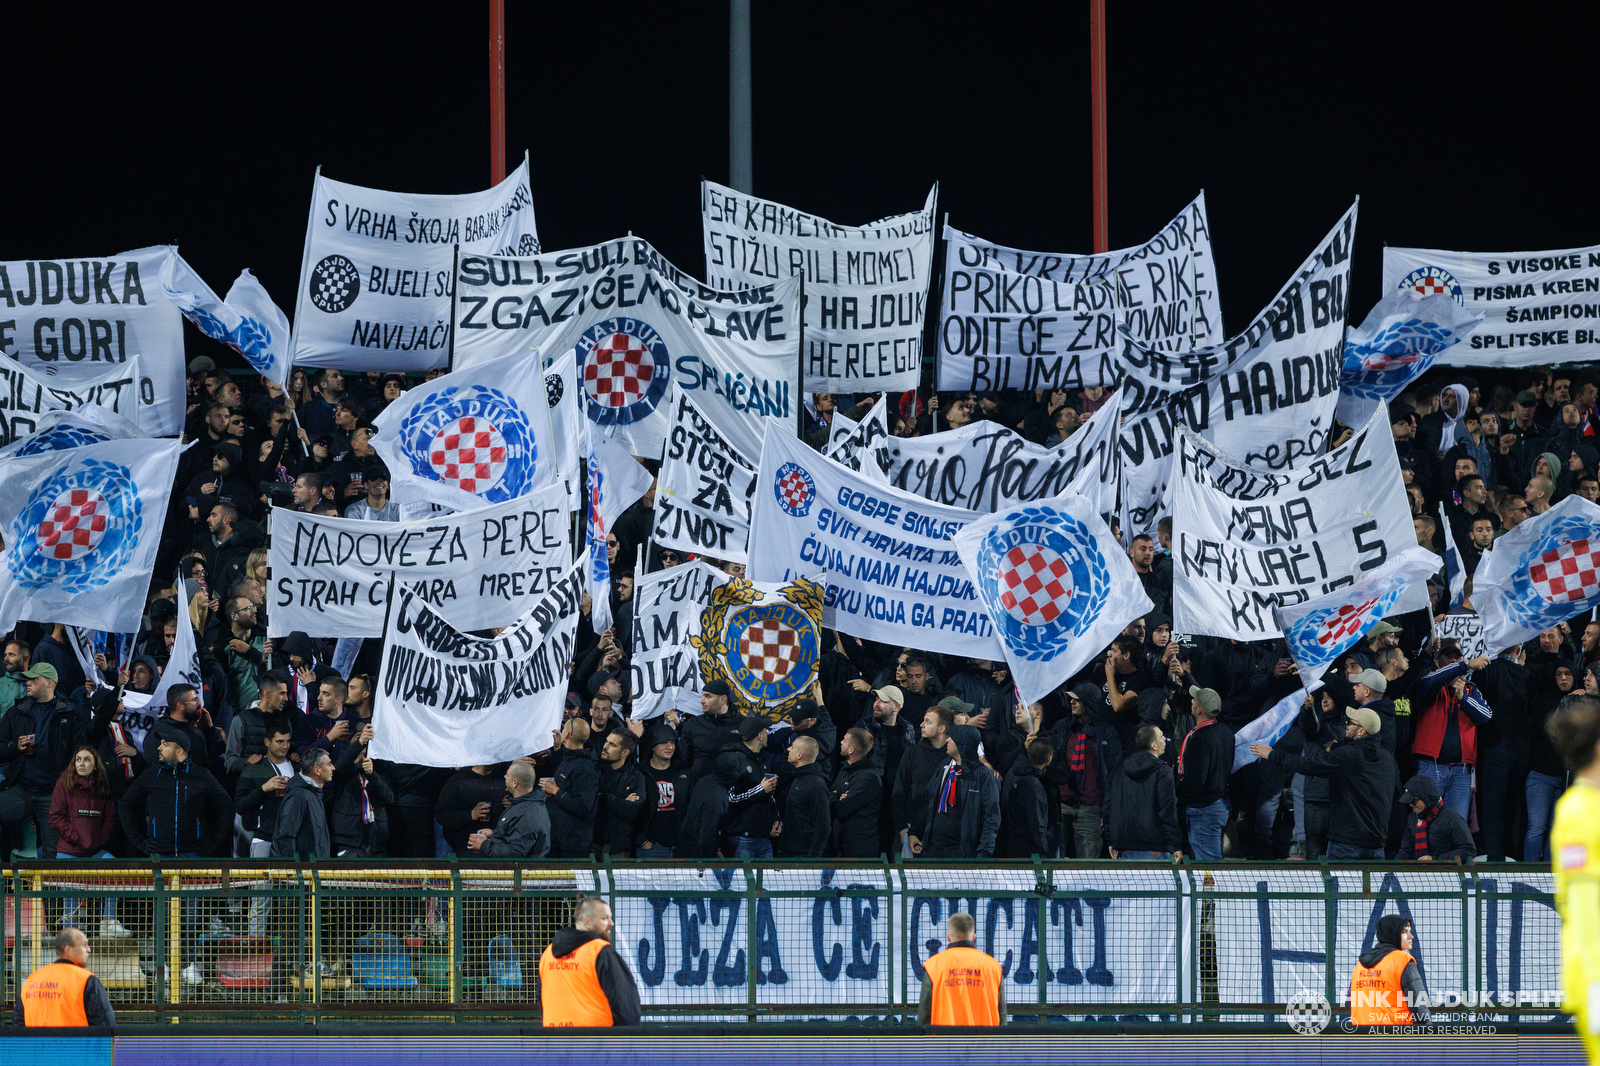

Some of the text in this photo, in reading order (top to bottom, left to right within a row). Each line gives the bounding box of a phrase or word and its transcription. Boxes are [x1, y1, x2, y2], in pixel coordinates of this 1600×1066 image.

[325, 199, 339, 227] S
[345, 204, 397, 241] VRHA
[405, 211, 460, 244] ŠKOJA
[315, 256, 358, 282] HAJDUK
[710, 230, 779, 279] STIŽU
[847, 247, 916, 286] MOMCI
[1487, 262, 1501, 275] S
[1506, 254, 1582, 275] VISOKE
[368, 265, 429, 298] BIJELI
[951, 270, 1043, 314] PRIKO
[1401, 266, 1459, 290] HAJDUK
[1473, 282, 1536, 301] PISMA
[313, 294, 346, 312] SPLIT
[1506, 303, 1600, 324] ŠAMPION
[33, 317, 127, 362] GORI
[350, 319, 449, 351] NAVIJAČI
[577, 319, 664, 352] HAJDUK
[943, 313, 1010, 357] ODIT
[1470, 329, 1570, 350] SPLITSKE
[421, 400, 512, 439] HAJDUK
[655, 496, 735, 551] ŽIVOT
[837, 485, 902, 526] GOSPE
[1226, 496, 1318, 544] MANA
[482, 508, 562, 558] PERE
[817, 507, 861, 542] SVIH
[861, 528, 934, 563] HRVATA
[799, 532, 855, 576] ČUVAJ
[855, 558, 901, 588] NAM
[988, 525, 1055, 582] HAJDUK
[1180, 532, 1328, 587] NAVIJAČI
[277, 577, 359, 612] STRAH
[480, 560, 563, 600] MREŽE
[732, 606, 812, 640] HAJDUK
[863, 596, 906, 626] KOJA
[911, 602, 936, 629] GA
[940, 607, 994, 639] PRATI
[1018, 585, 1090, 644] SPLIT
[736, 669, 796, 699] SPLIT
[549, 962, 579, 971] SECURITY
[945, 978, 985, 988] SECURITY
[949, 968, 981, 977] KLEMM
[25, 991, 62, 1000] SECURITY
